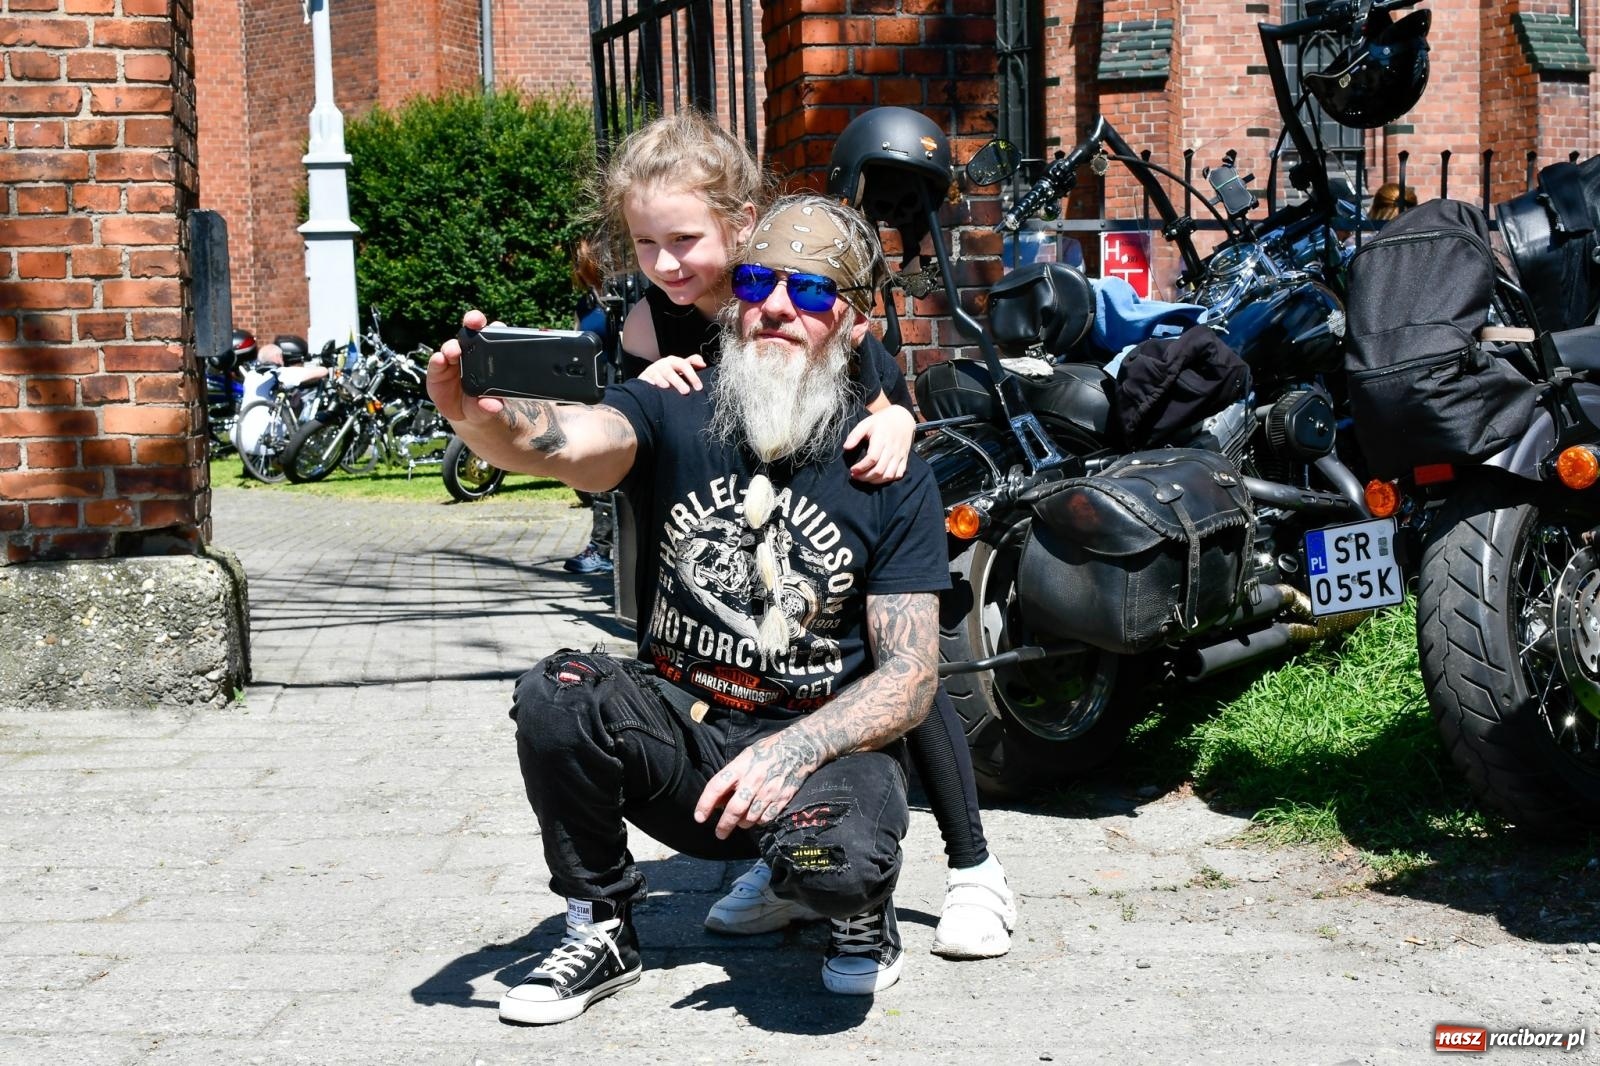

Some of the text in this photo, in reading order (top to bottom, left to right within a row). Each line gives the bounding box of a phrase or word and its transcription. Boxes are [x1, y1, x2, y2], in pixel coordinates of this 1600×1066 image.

[1334, 532, 1371, 564] SR
[1310, 556, 1326, 571] PL
[1316, 566, 1395, 606] 055K
[810, 619, 841, 629] 1903
[695, 670, 780, 703] HARLEY-DAVIDSON
[795, 675, 836, 700] GET
